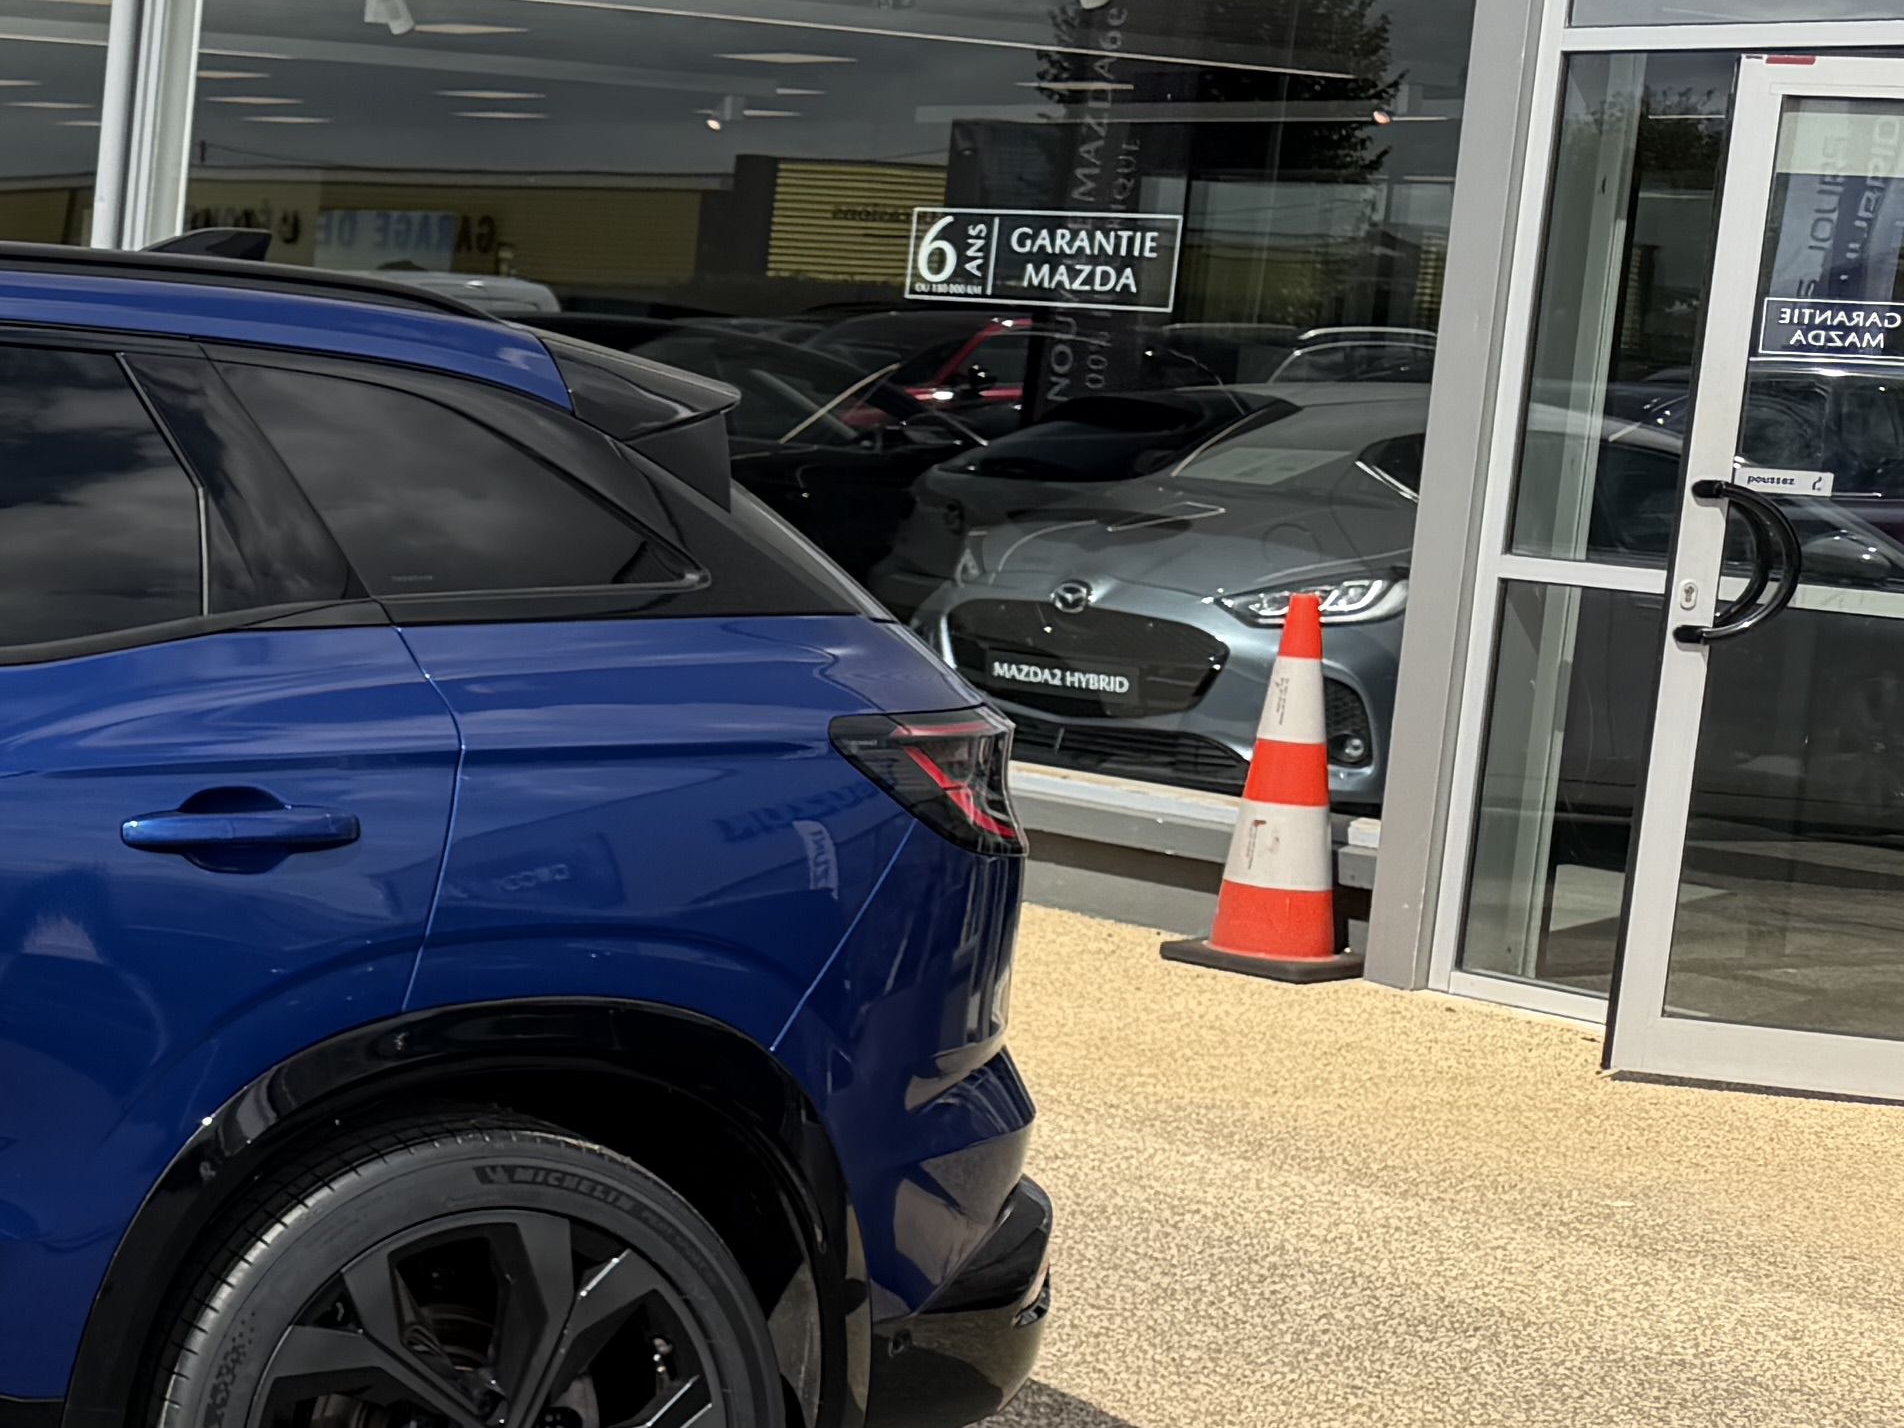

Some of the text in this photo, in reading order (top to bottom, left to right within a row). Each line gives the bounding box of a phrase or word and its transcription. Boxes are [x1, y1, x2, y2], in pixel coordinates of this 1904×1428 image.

[917, 215, 988, 283] 6 ANS
[1010, 227, 1159, 258] GARANTIE
[1022, 263, 1138, 293] MAZDA
[1747, 475, 1795, 486] poussez
[993, 661, 1130, 693] MAZDA2 HYBRID
